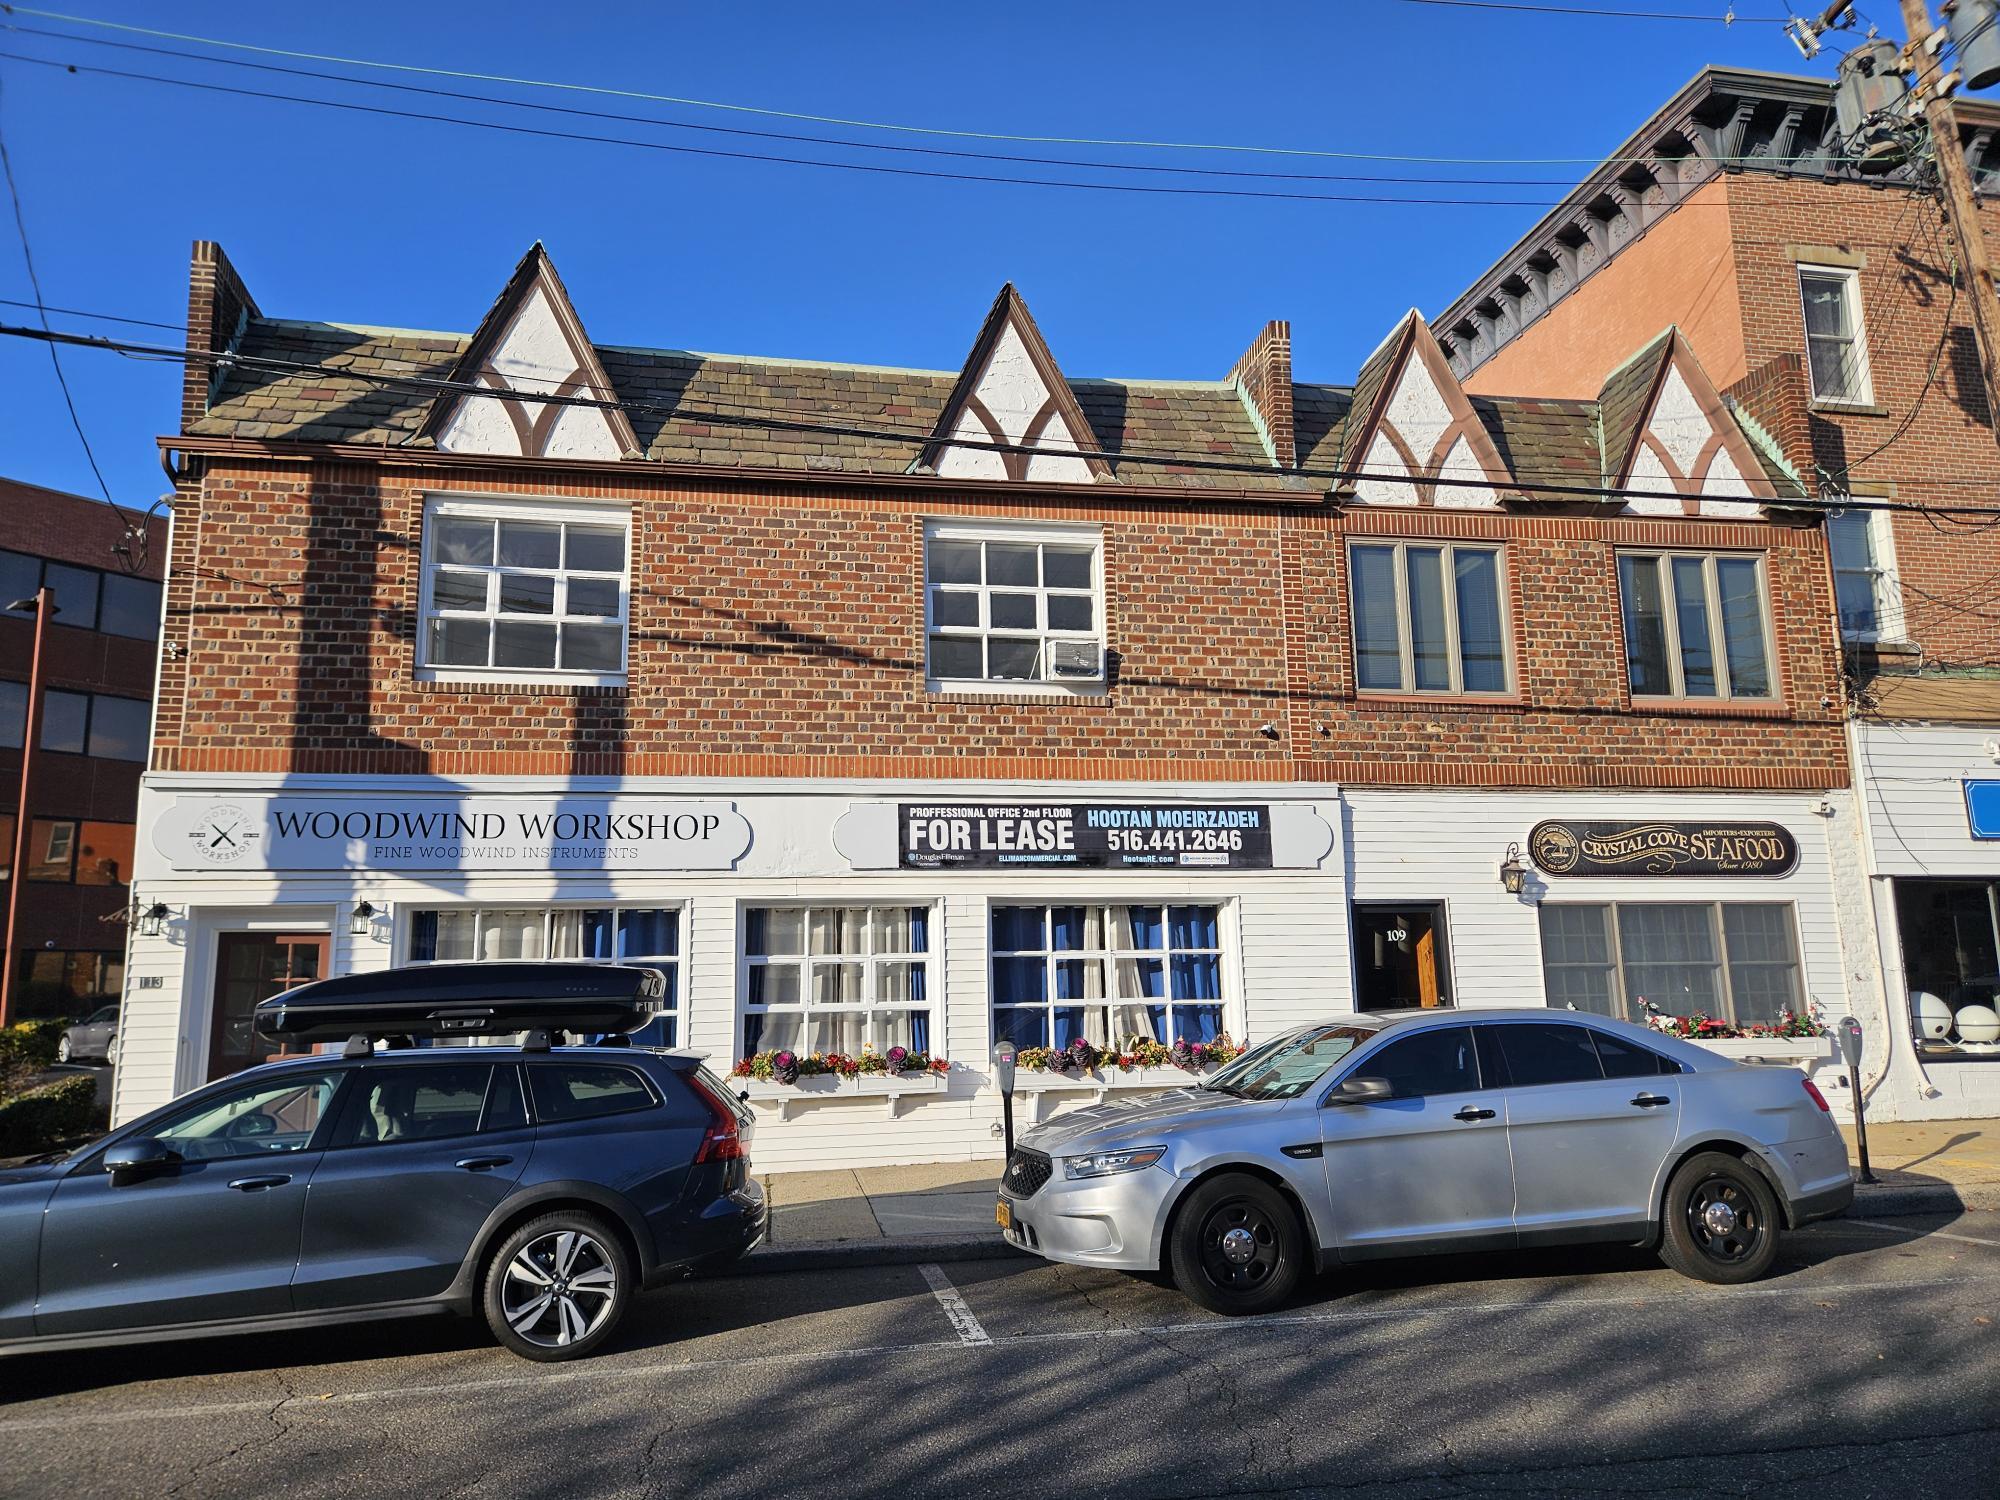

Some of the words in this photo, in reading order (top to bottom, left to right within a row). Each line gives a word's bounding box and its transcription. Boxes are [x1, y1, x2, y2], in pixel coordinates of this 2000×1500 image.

[910, 807, 985, 818] PROFFESSIONAL
[988, 808, 1020, 818] OFFICE
[1023, 807, 1040, 818] 2nd
[1043, 807, 1072, 818] FLOOR
[1087, 809, 1152, 828] HOOTAN
[1156, 810, 1259, 828] MOEIRZADEH
[273, 811, 505, 839] WOODWIND
[517, 813, 720, 841] WORKSHOP
[909, 819, 972, 850] FOR
[979, 819, 1075, 850] LEASE
[1107, 829, 1242, 851] 516.441.2646
[1581, 836, 1647, 857] CRYSTAL
[1647, 832, 1689, 849] COVE
[1690, 833, 1785, 861] SEAFOOD
[374, 847, 412, 858] FINE
[419, 847, 516, 859] WOODWIND
[523, 847, 639, 859] INSTRUMENTS
[1386, 929, 1407, 942] 109
[141, 977, 162, 988] 113
